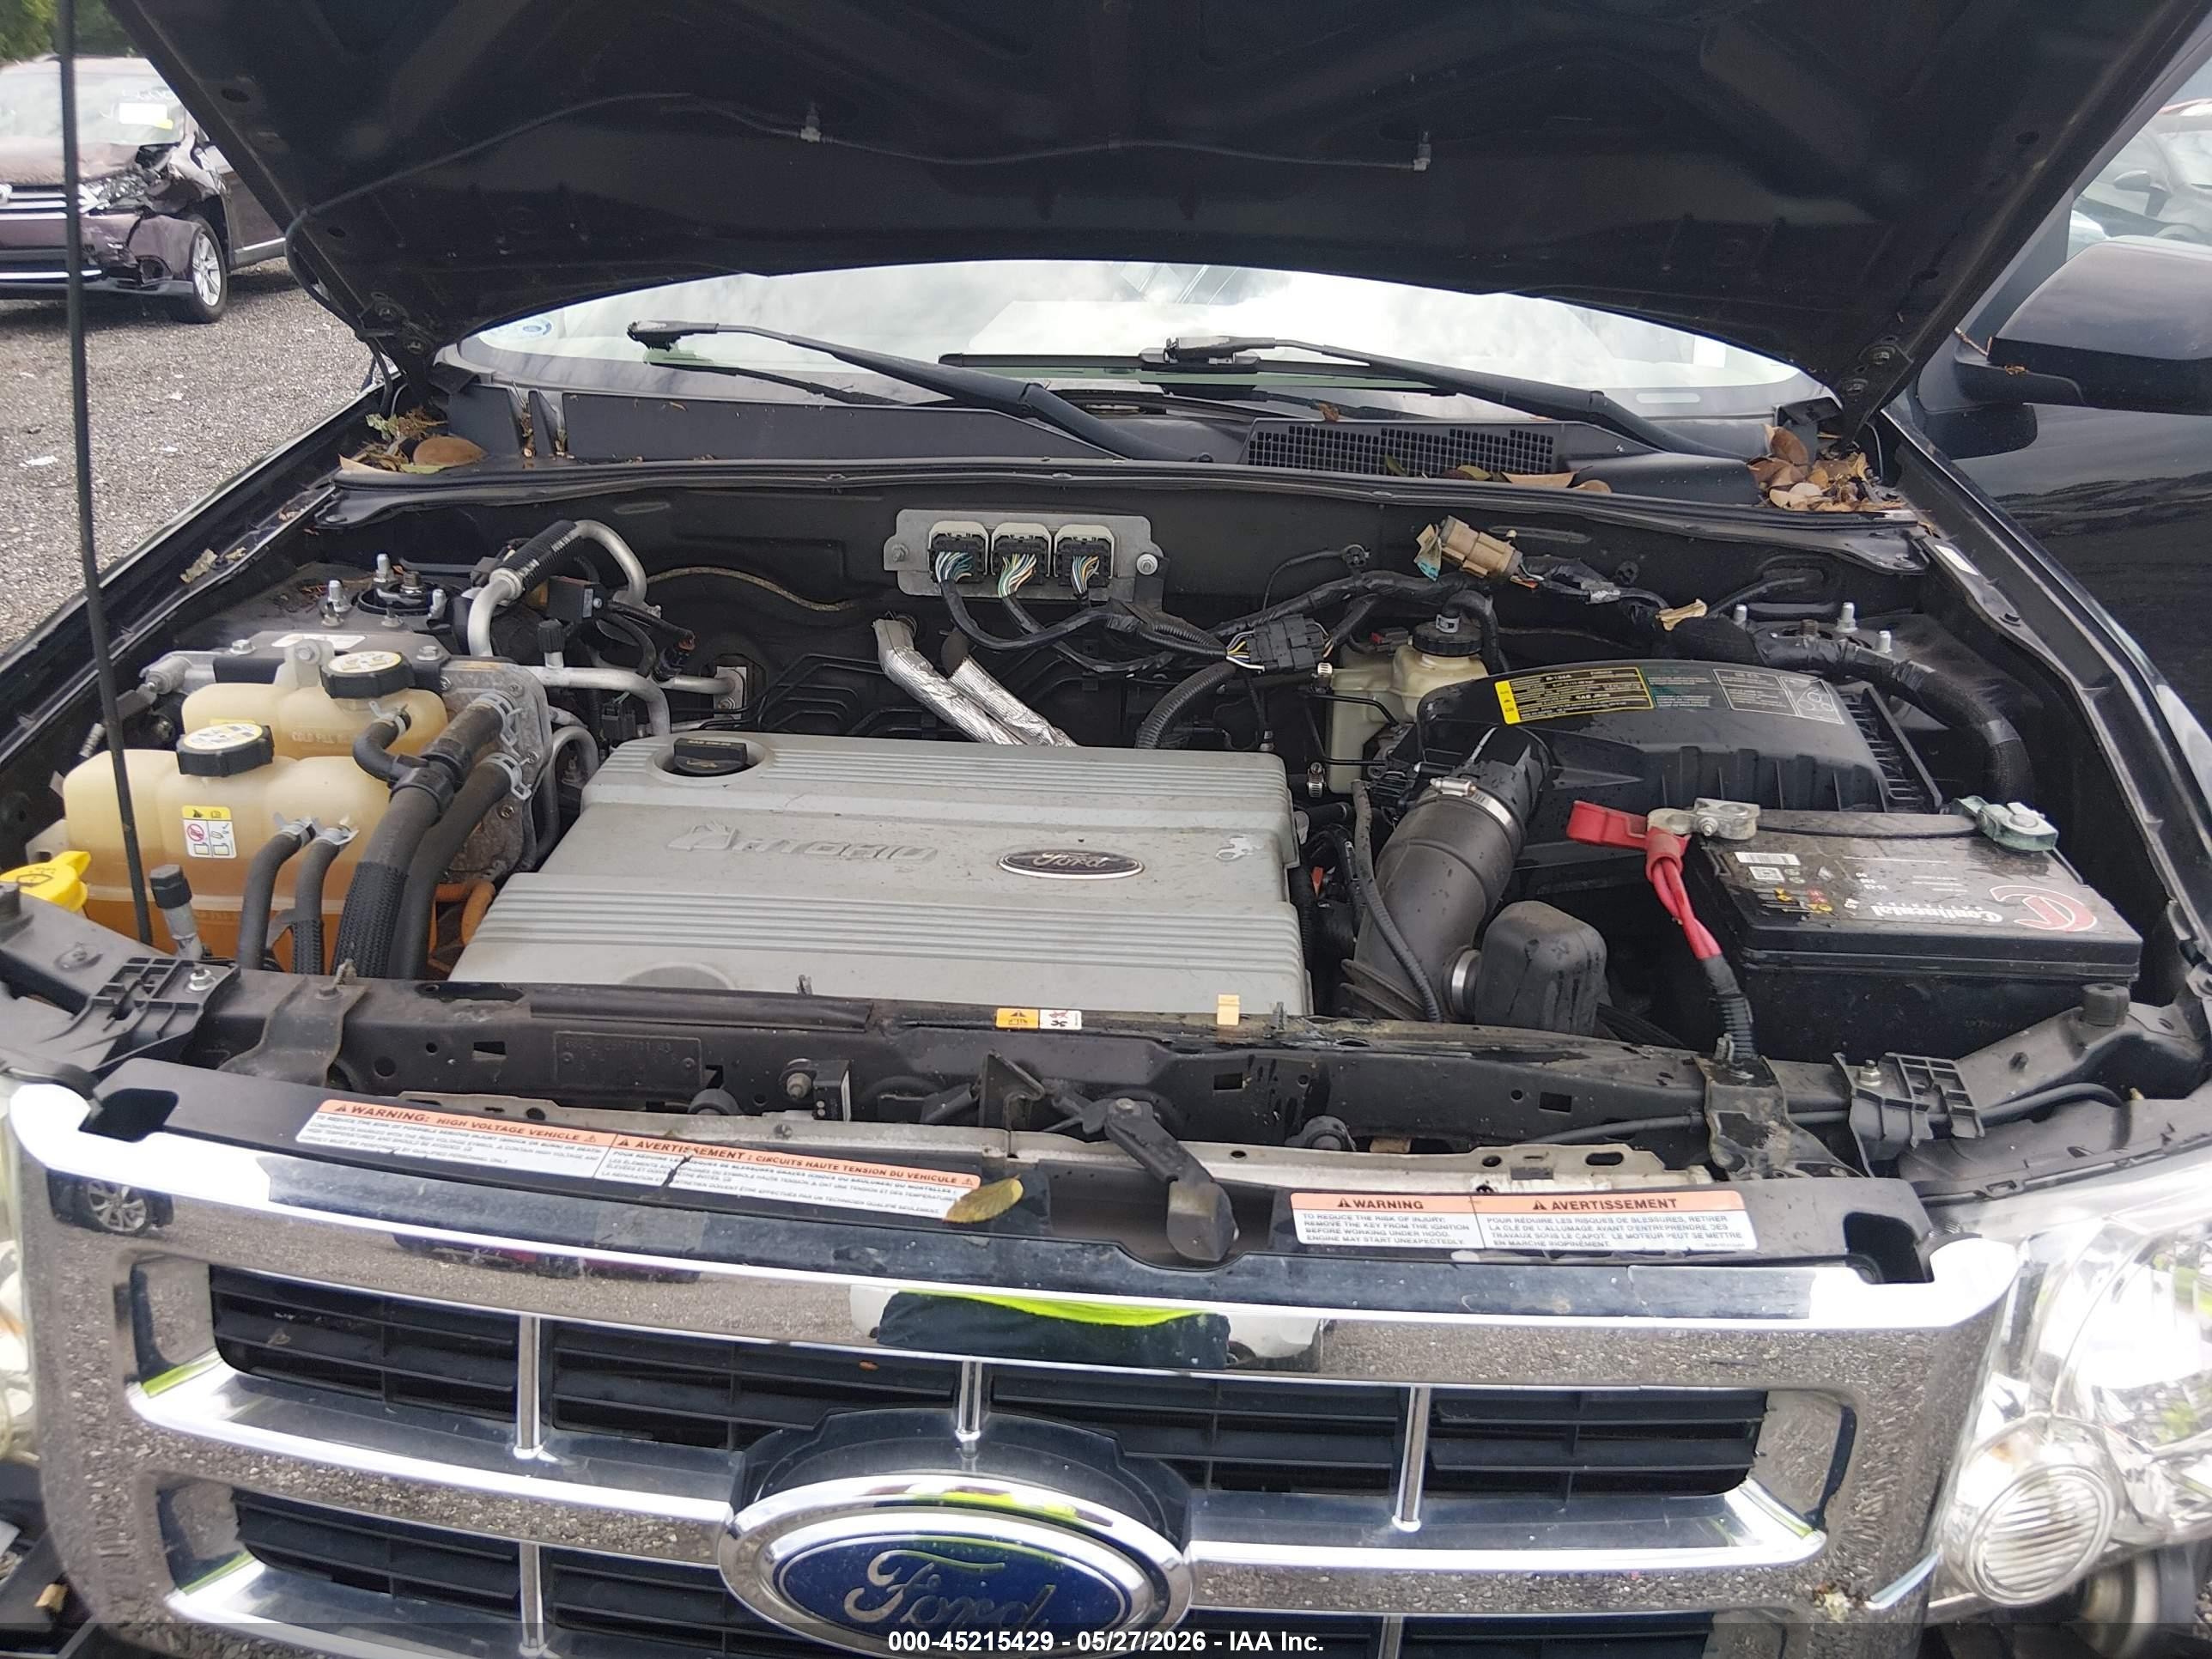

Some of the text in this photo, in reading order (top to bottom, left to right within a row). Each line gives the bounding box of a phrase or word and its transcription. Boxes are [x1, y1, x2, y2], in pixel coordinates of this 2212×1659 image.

[1032, 852, 1107, 867] Ford
[350, 1106, 580, 1139] WARNING: HIGH VOLTAGE VEHICLE
[635, 1140, 747, 1160] AVERTISSEMENT
[756, 1154, 802, 1166] CIRCUITS
[805, 1160, 838, 1170] HAUTE
[842, 1164, 886, 1176] TENSION
[1352, 1199, 1424, 1210] WARNING
[1552, 1199, 1677, 1210] AVERTISSEMENT
[844, 1549, 1057, 1632] Ford
